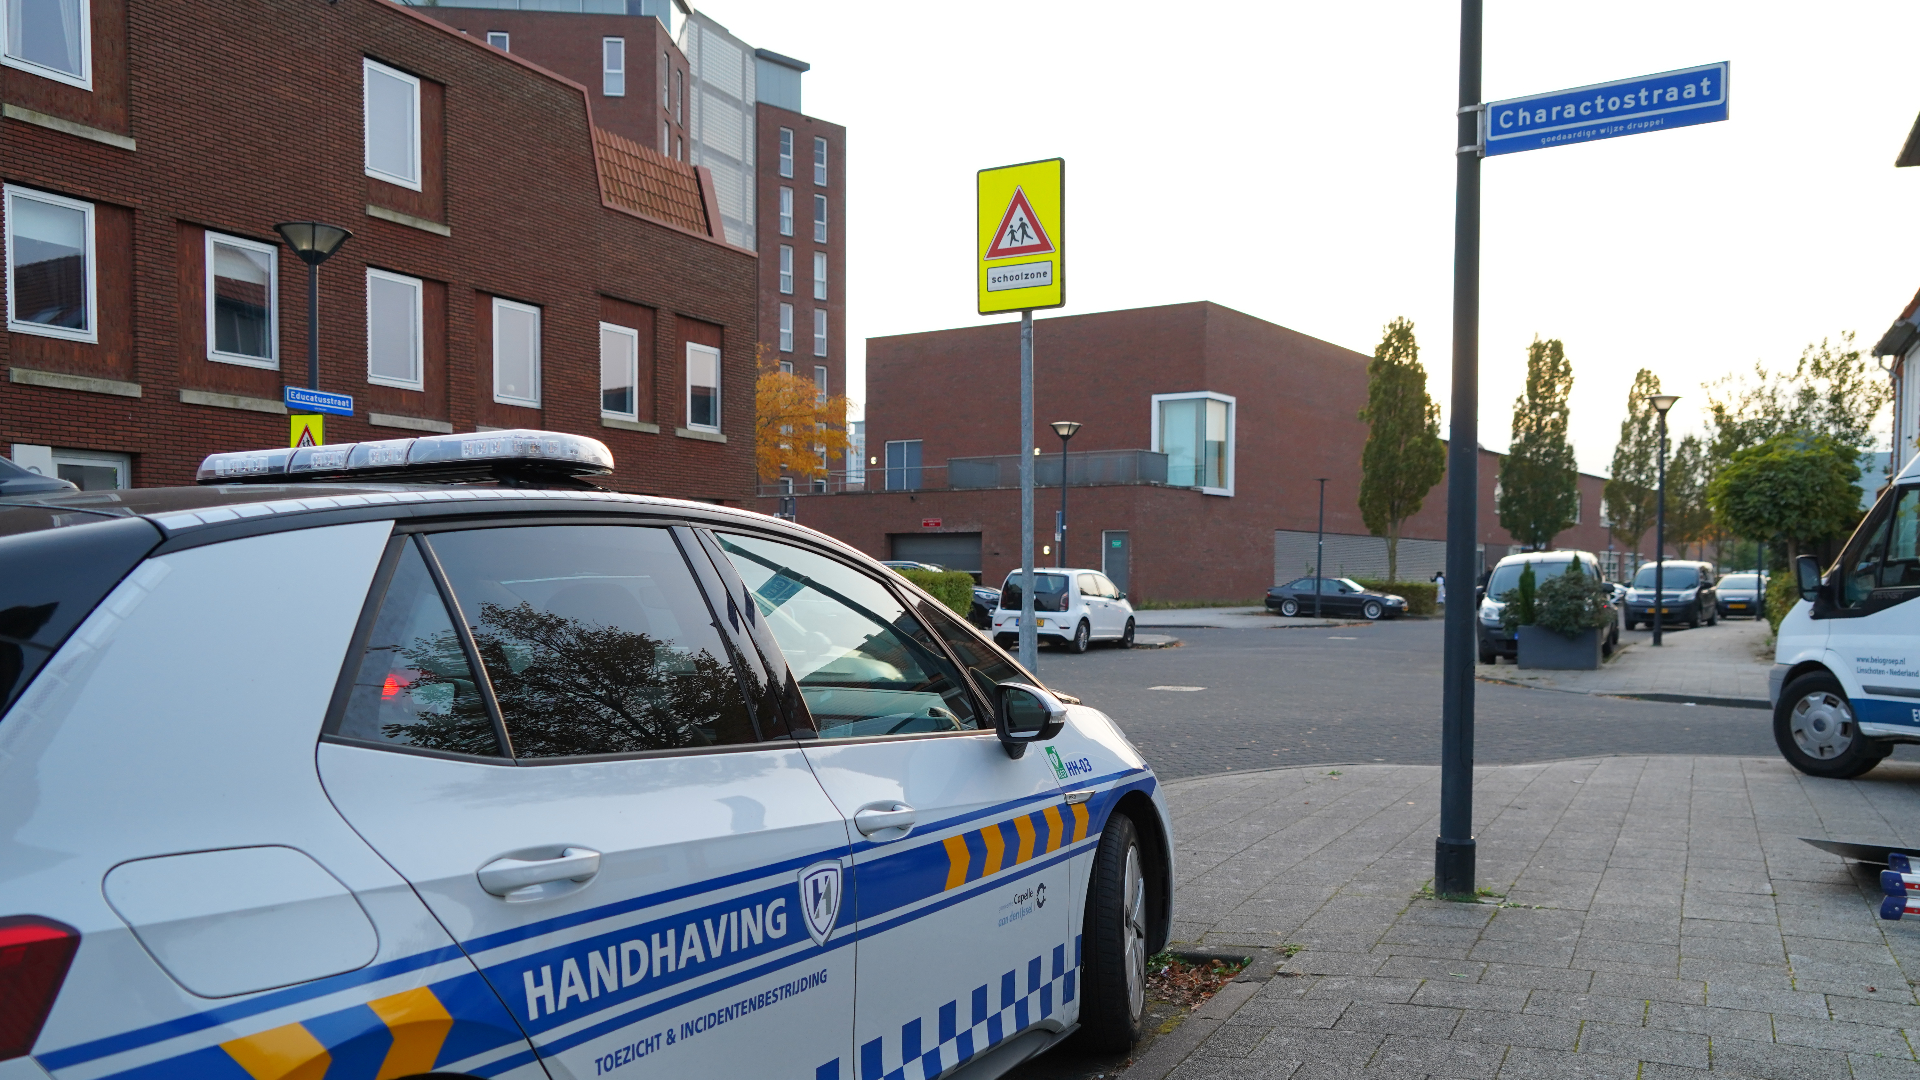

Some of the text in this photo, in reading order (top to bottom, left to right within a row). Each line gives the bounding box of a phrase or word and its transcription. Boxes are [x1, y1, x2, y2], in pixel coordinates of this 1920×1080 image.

[1499, 77, 1712, 129] Charactostraat
[1541, 118, 1665, 145] goedaardige wijze druppel
[991, 271, 1048, 284] schoolzone
[290, 391, 350, 407] Educatusstraat
[1856, 666, 1920, 678] Linschoten Nederland
[1065, 757, 1093, 777] HH-03
[1013, 888, 1034, 906] Capelle
[522, 897, 788, 1022] HANDHAVING
[594, 968, 828, 1077] TOEZICHT & INCIDENTENBESTRIJDING
